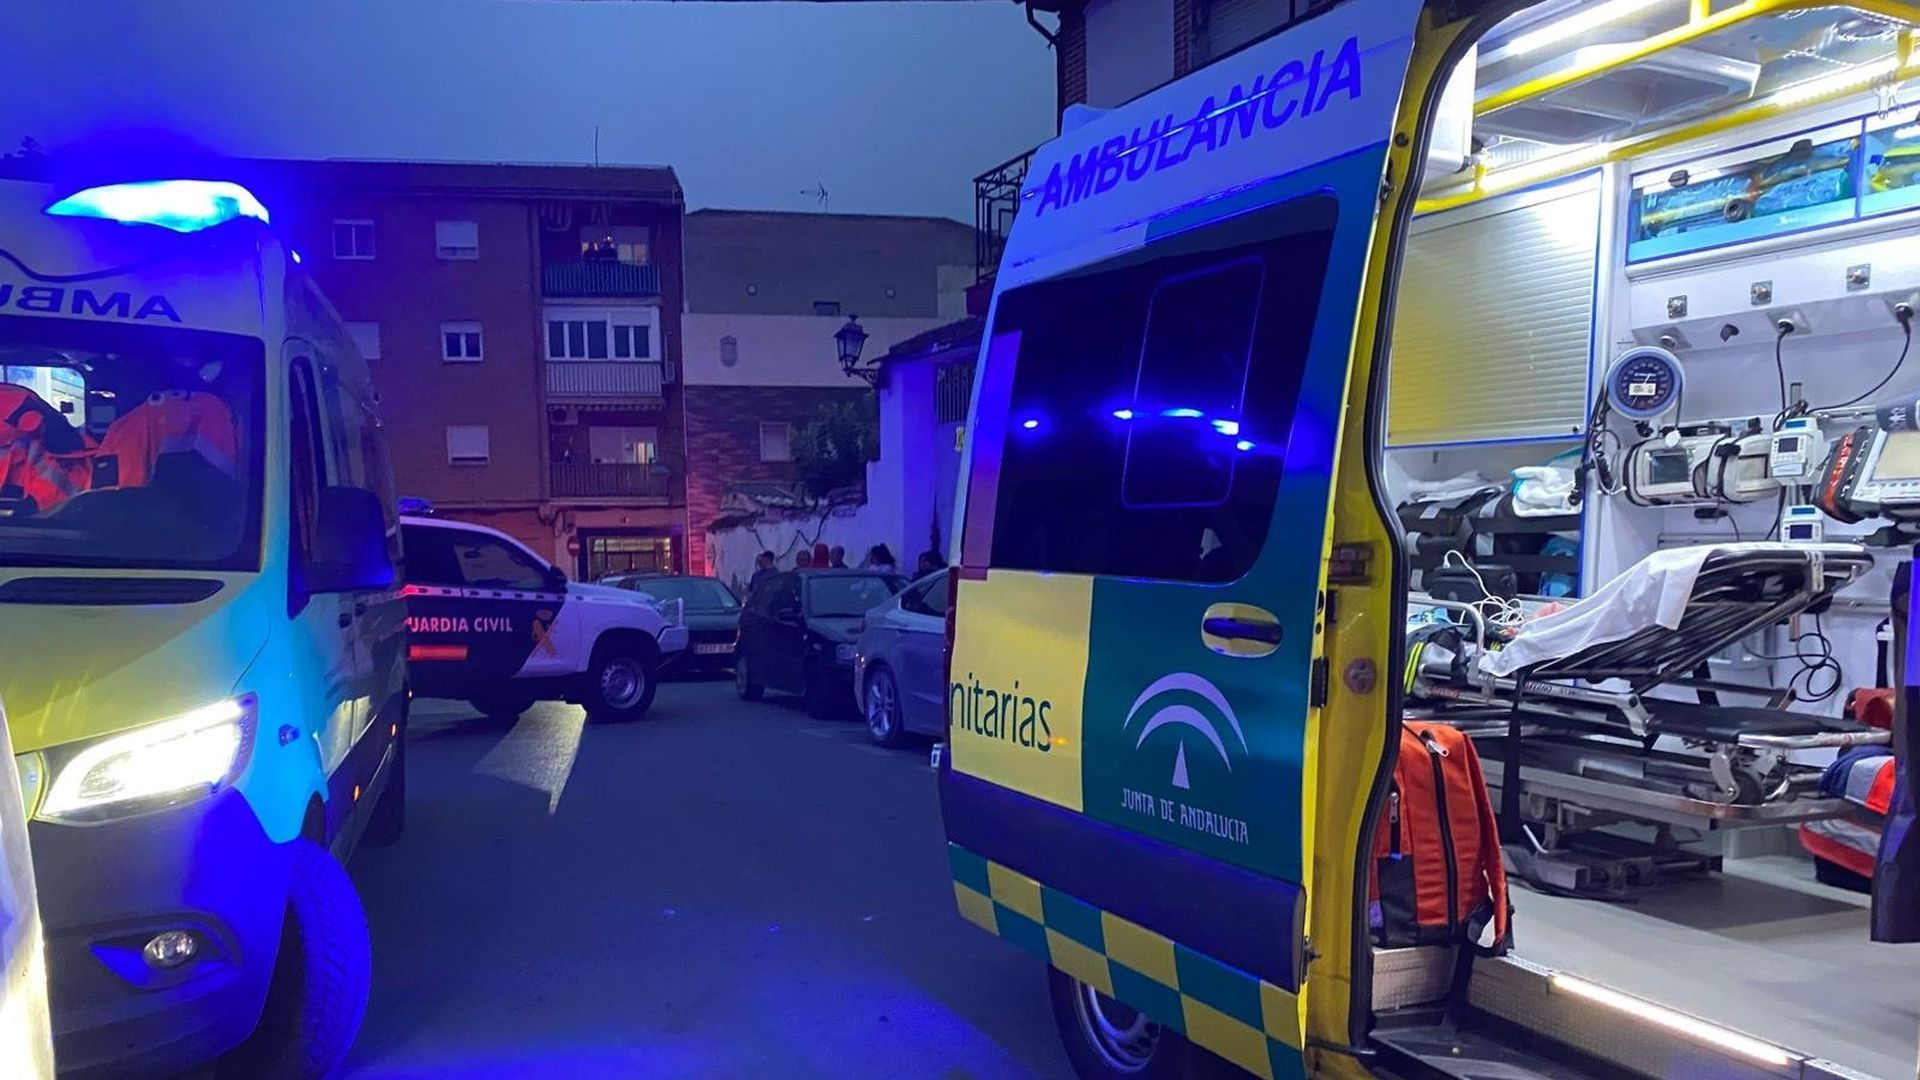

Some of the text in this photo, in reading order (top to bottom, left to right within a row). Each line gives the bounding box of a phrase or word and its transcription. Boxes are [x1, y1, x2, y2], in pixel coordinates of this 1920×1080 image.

[1036, 36, 1361, 218] AMBULANCIA
[405, 617, 513, 632] UARDIA CIVIL
[950, 672, 1051, 752] nitarias
[1121, 788, 1248, 845] JUNTA DE ANDALUCIA
